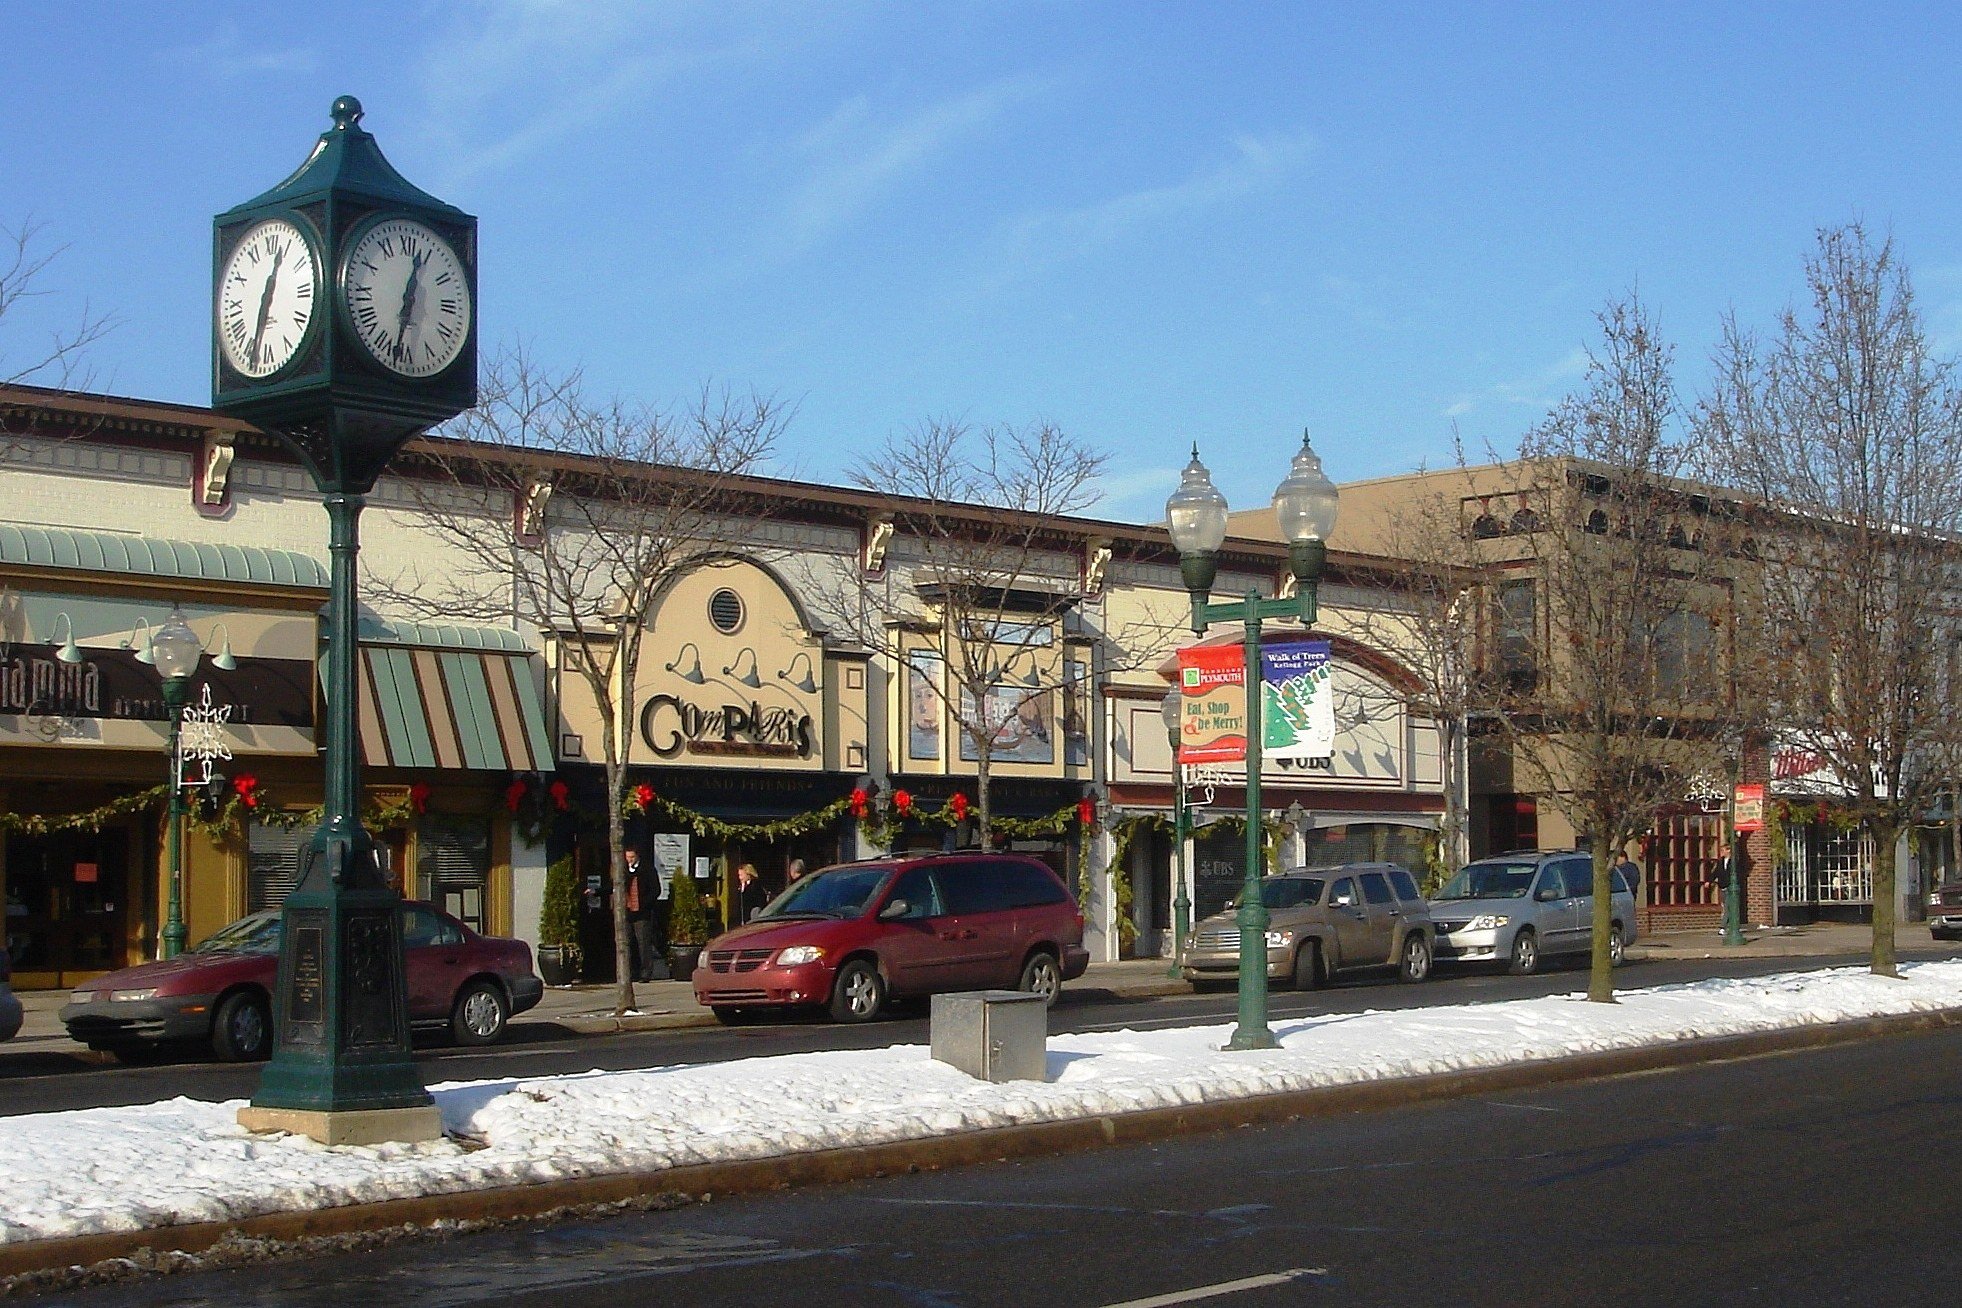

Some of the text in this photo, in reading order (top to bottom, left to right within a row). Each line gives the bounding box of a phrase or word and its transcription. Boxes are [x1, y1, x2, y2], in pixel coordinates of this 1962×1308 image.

[1268, 652, 1325, 662] Walk of Trees
[1200, 672, 1242, 684] PLYMOUTH
[1187, 701, 1230, 716] Eat, Shop
[1212, 716, 1242, 730] Merry!
[1213, 861, 1234, 876] UBS
